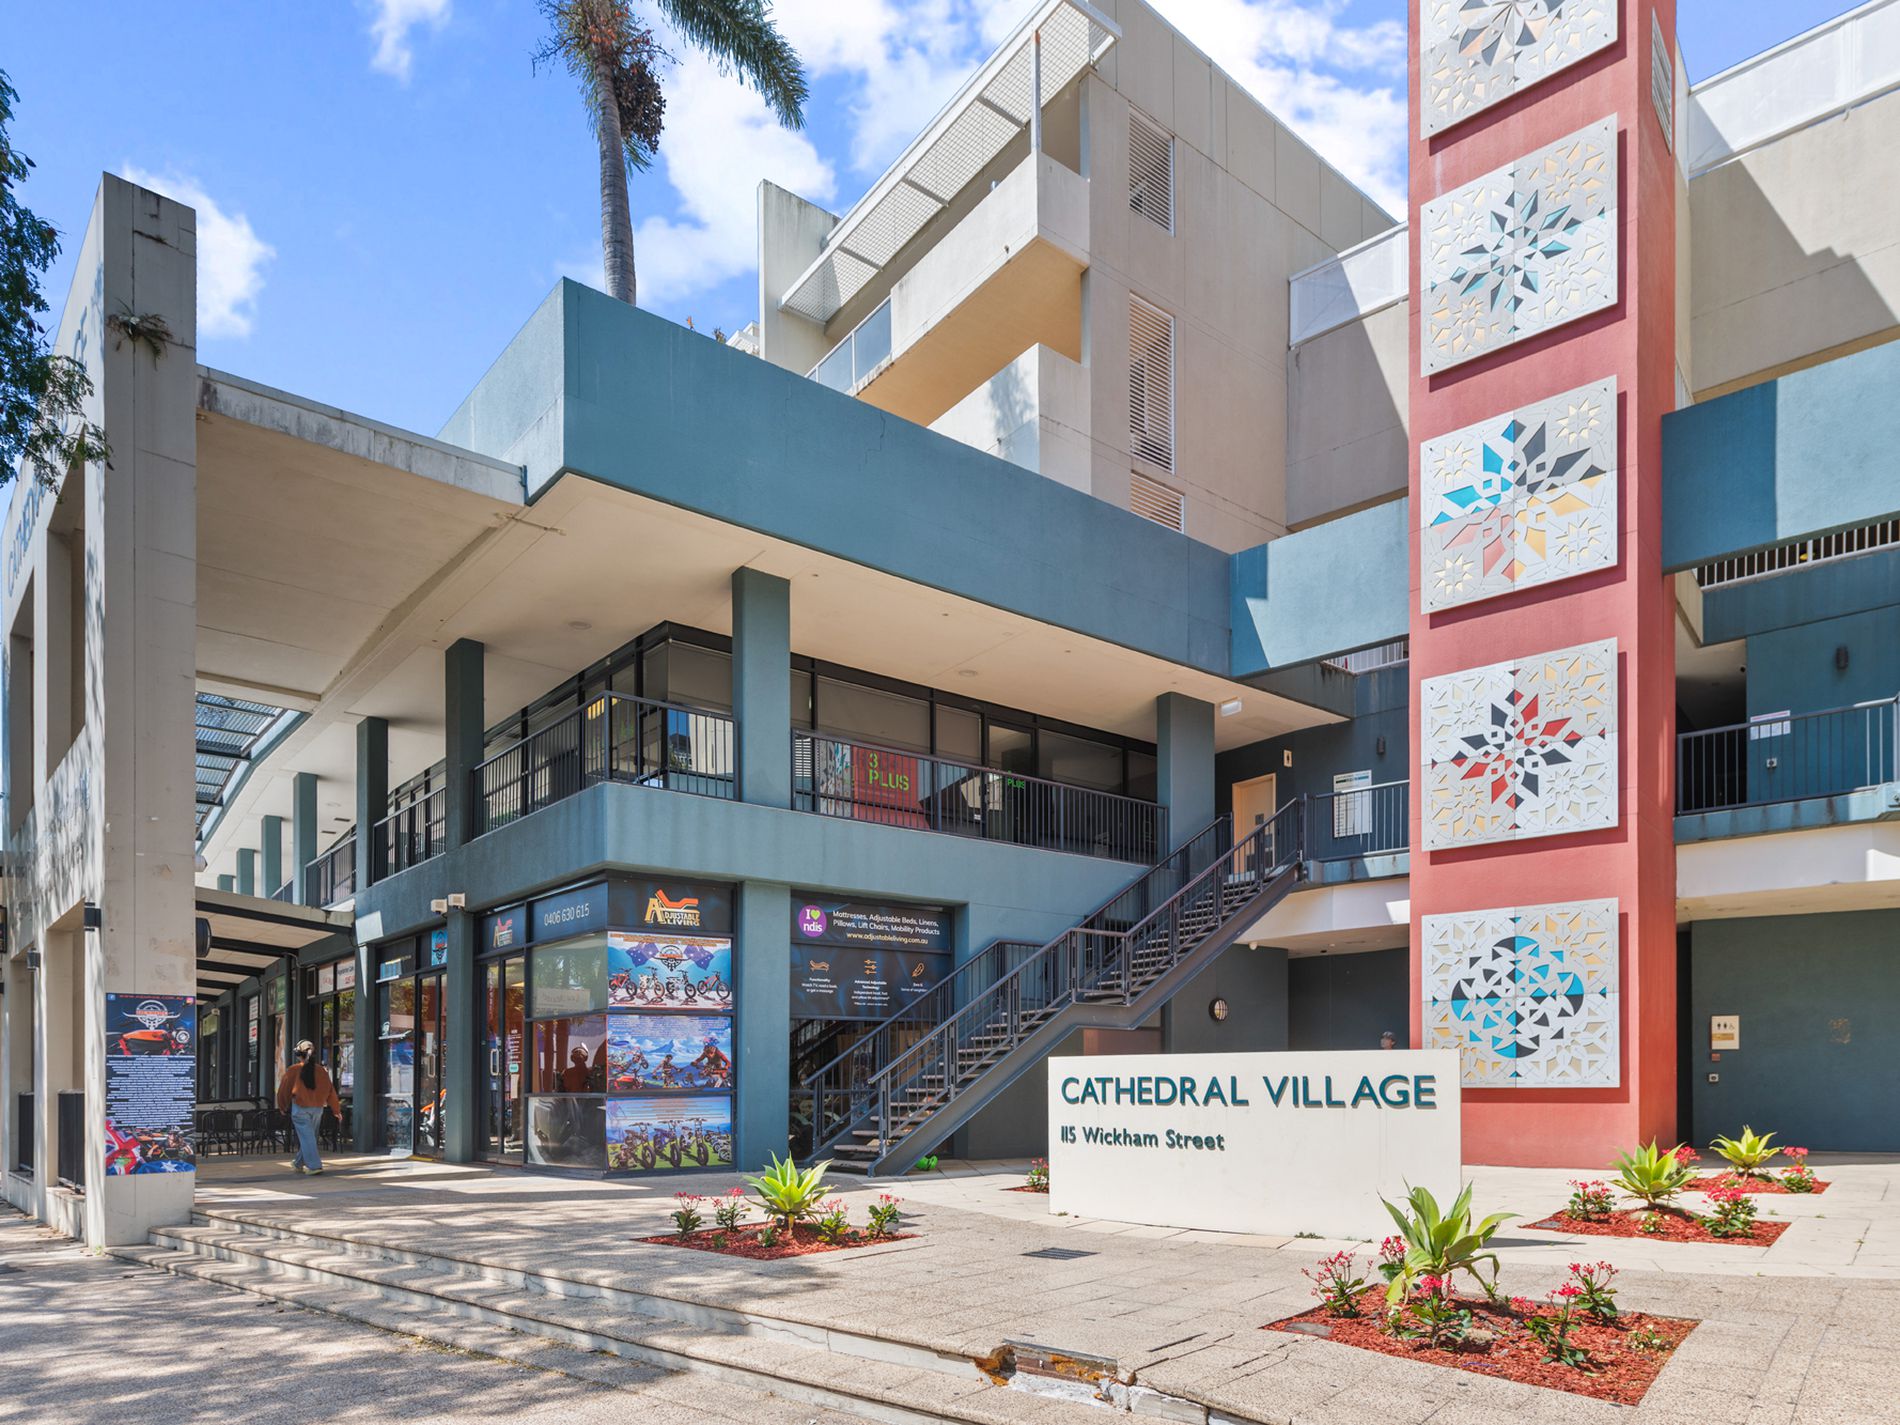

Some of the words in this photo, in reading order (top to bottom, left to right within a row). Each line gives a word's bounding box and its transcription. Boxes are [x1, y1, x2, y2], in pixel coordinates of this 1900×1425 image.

[869, 752, 879, 769] 3
[868, 769, 909, 791] PLUS
[543, 908, 561, 926] 0406
[561, 902, 575, 922] 630
[576, 898, 590, 919] 615
[805, 909, 811, 920] I
[869, 914, 901, 925] Adjustable
[667, 918, 700, 927] LIVING
[803, 921, 823, 933] ndis
[858, 921, 869, 930] Lift
[891, 925, 914, 935] Mobility
[914, 926, 940, 936] Products
[846, 932, 929, 945] www.adjustableliving.com.au
[1061, 1076, 1249, 1106] CATHEDRAL
[1263, 1074, 1437, 1108] VILLAGE
[1061, 1126, 1076, 1144] 115
[1082, 1127, 1159, 1148] Wickham
[1166, 1129, 1225, 1151] Street
